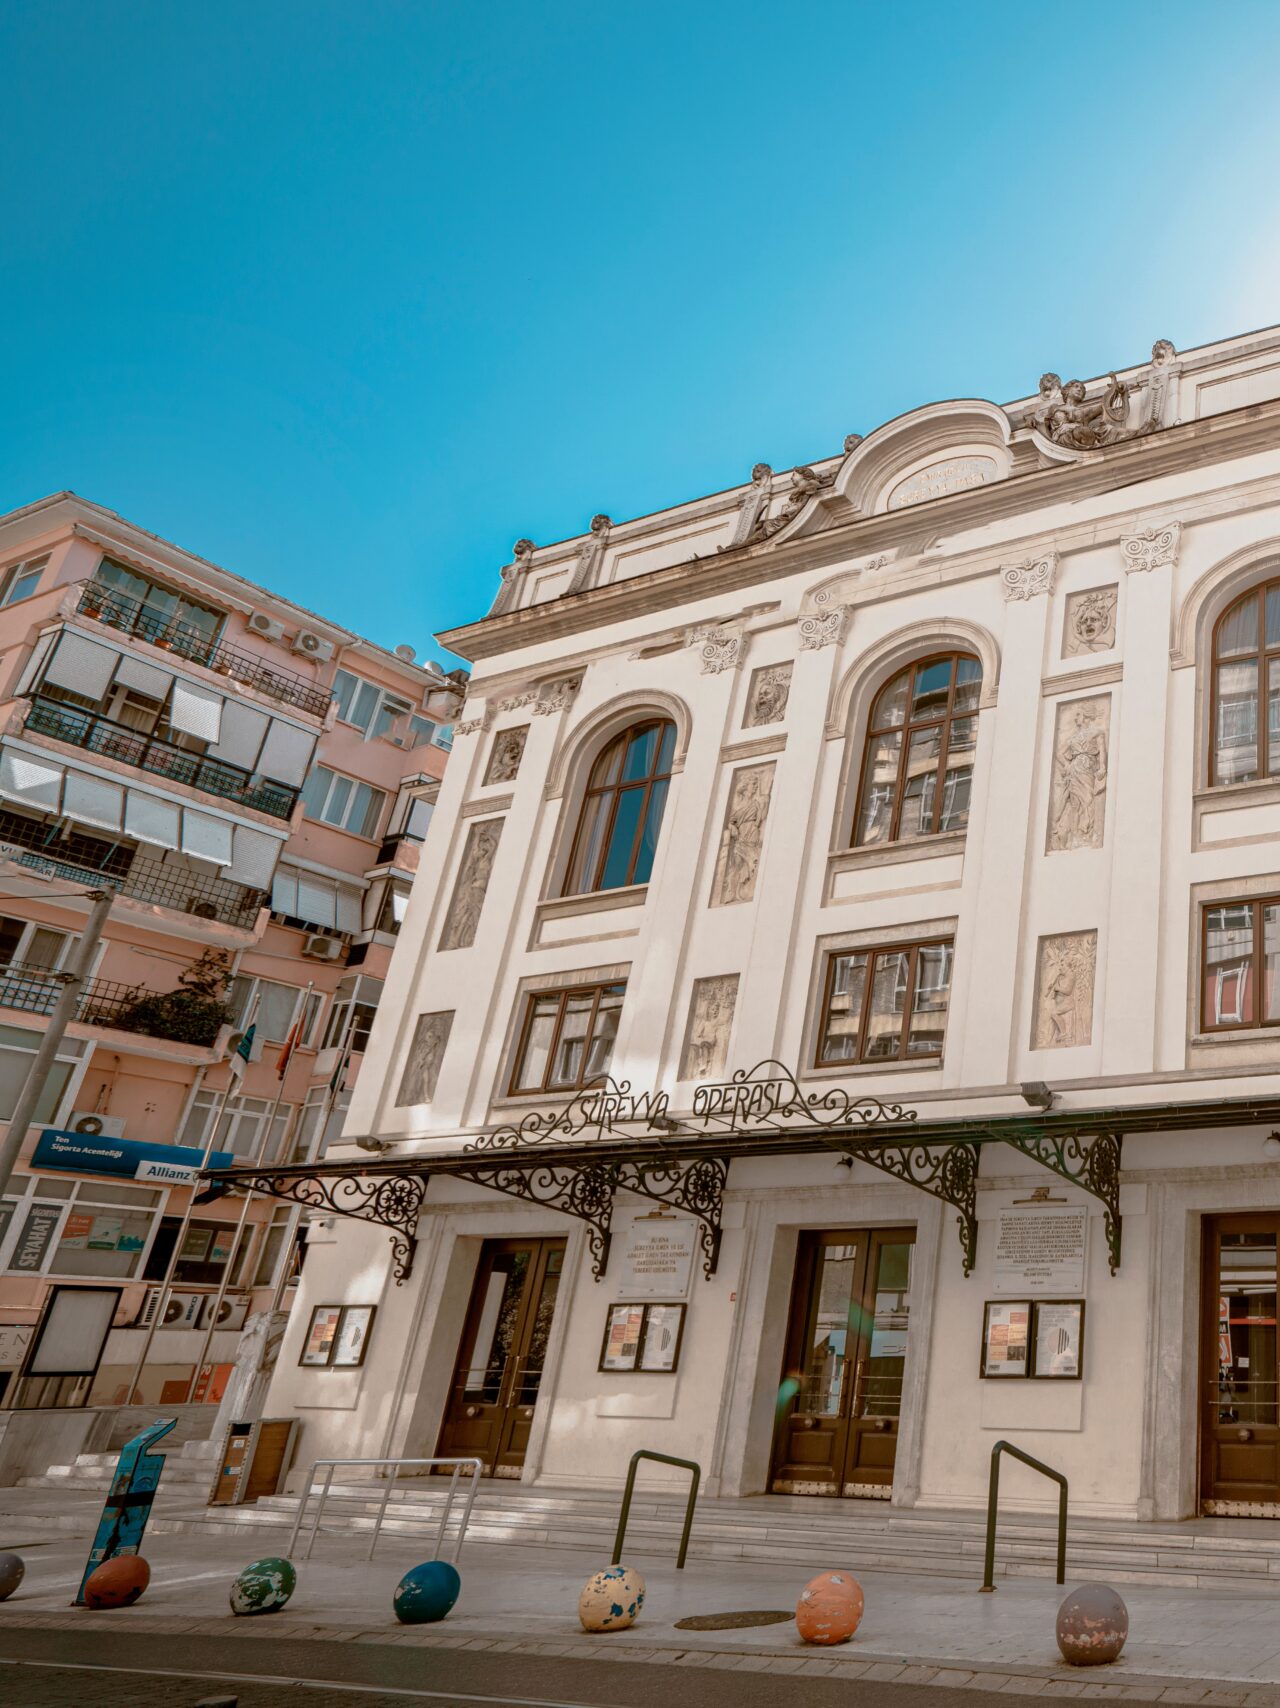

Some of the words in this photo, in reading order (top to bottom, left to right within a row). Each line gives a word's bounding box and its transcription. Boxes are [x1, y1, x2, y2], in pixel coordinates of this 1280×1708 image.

[571, 1091, 669, 1140] SÜREYYA
[693, 1083, 782, 1131] OPERASI
[55, 1135, 70, 1144] Ten
[51, 1143, 81, 1152] Sigorta
[146, 1165, 191, 1180] Allianz
[18, 1218, 53, 1268] SEYAHAT
